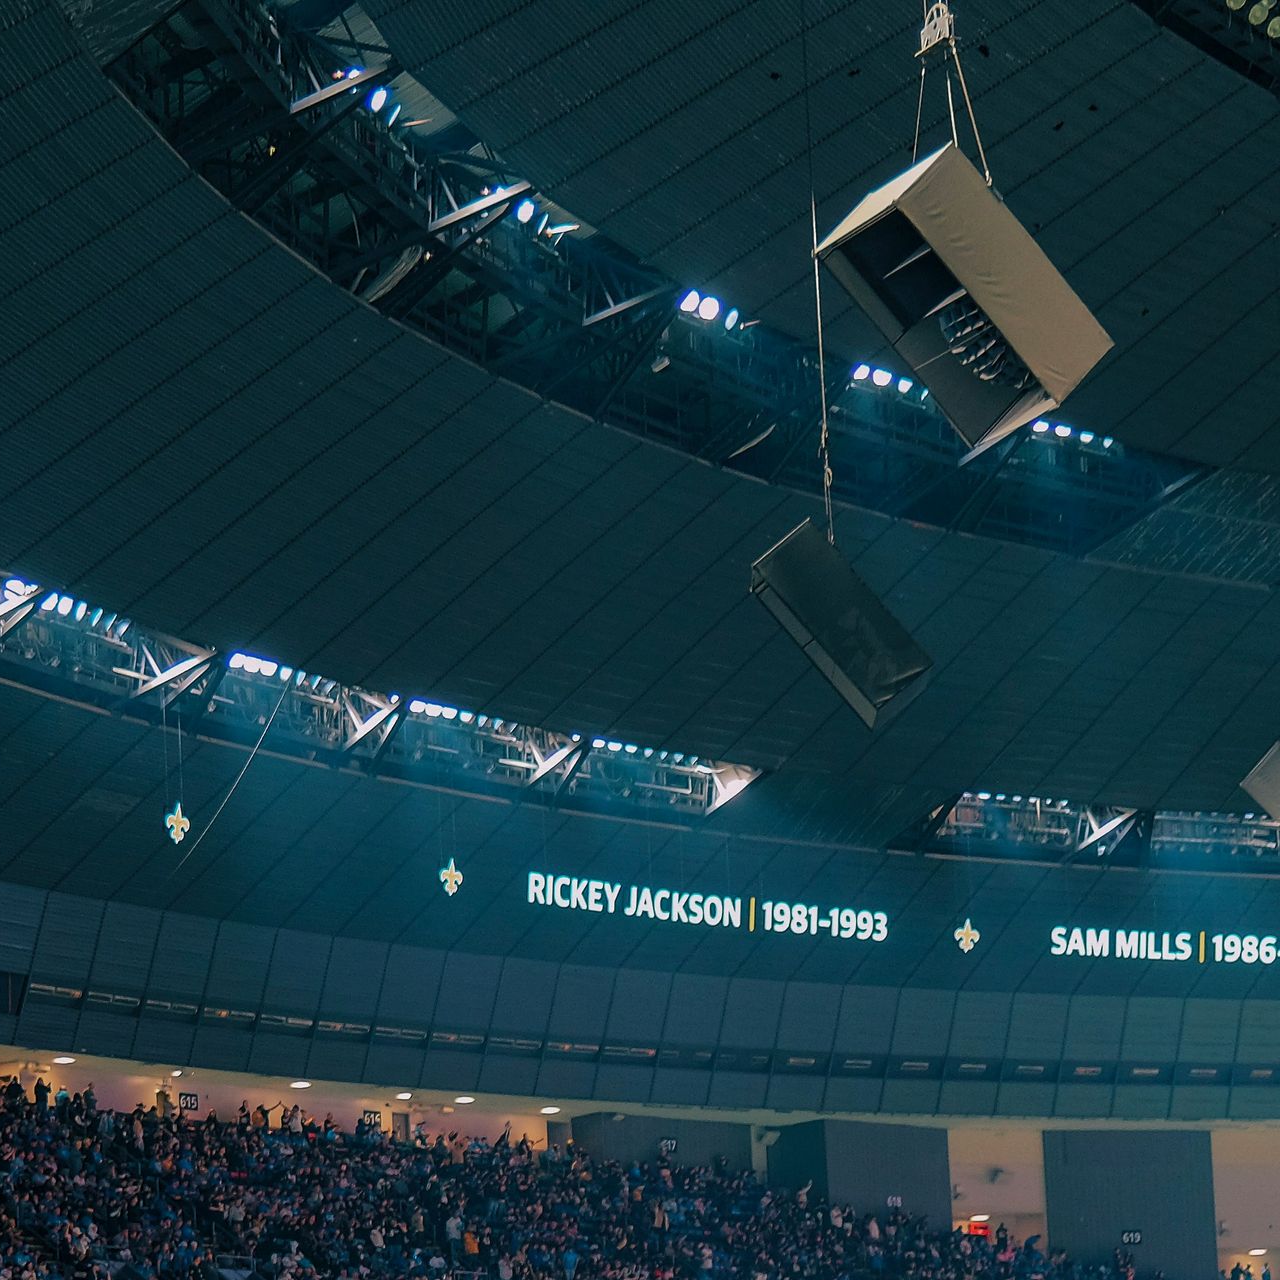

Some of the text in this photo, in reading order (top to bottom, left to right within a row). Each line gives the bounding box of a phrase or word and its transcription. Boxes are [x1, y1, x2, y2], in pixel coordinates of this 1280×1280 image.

[527, 872, 888, 942] RICKEY JACKSON 1981-1993
[1051, 926, 1110, 957] SAM
[1115, 929, 1192, 961] MILLS
[180, 1094, 198, 1110] 615
[1122, 1232, 1142, 1243] 619
